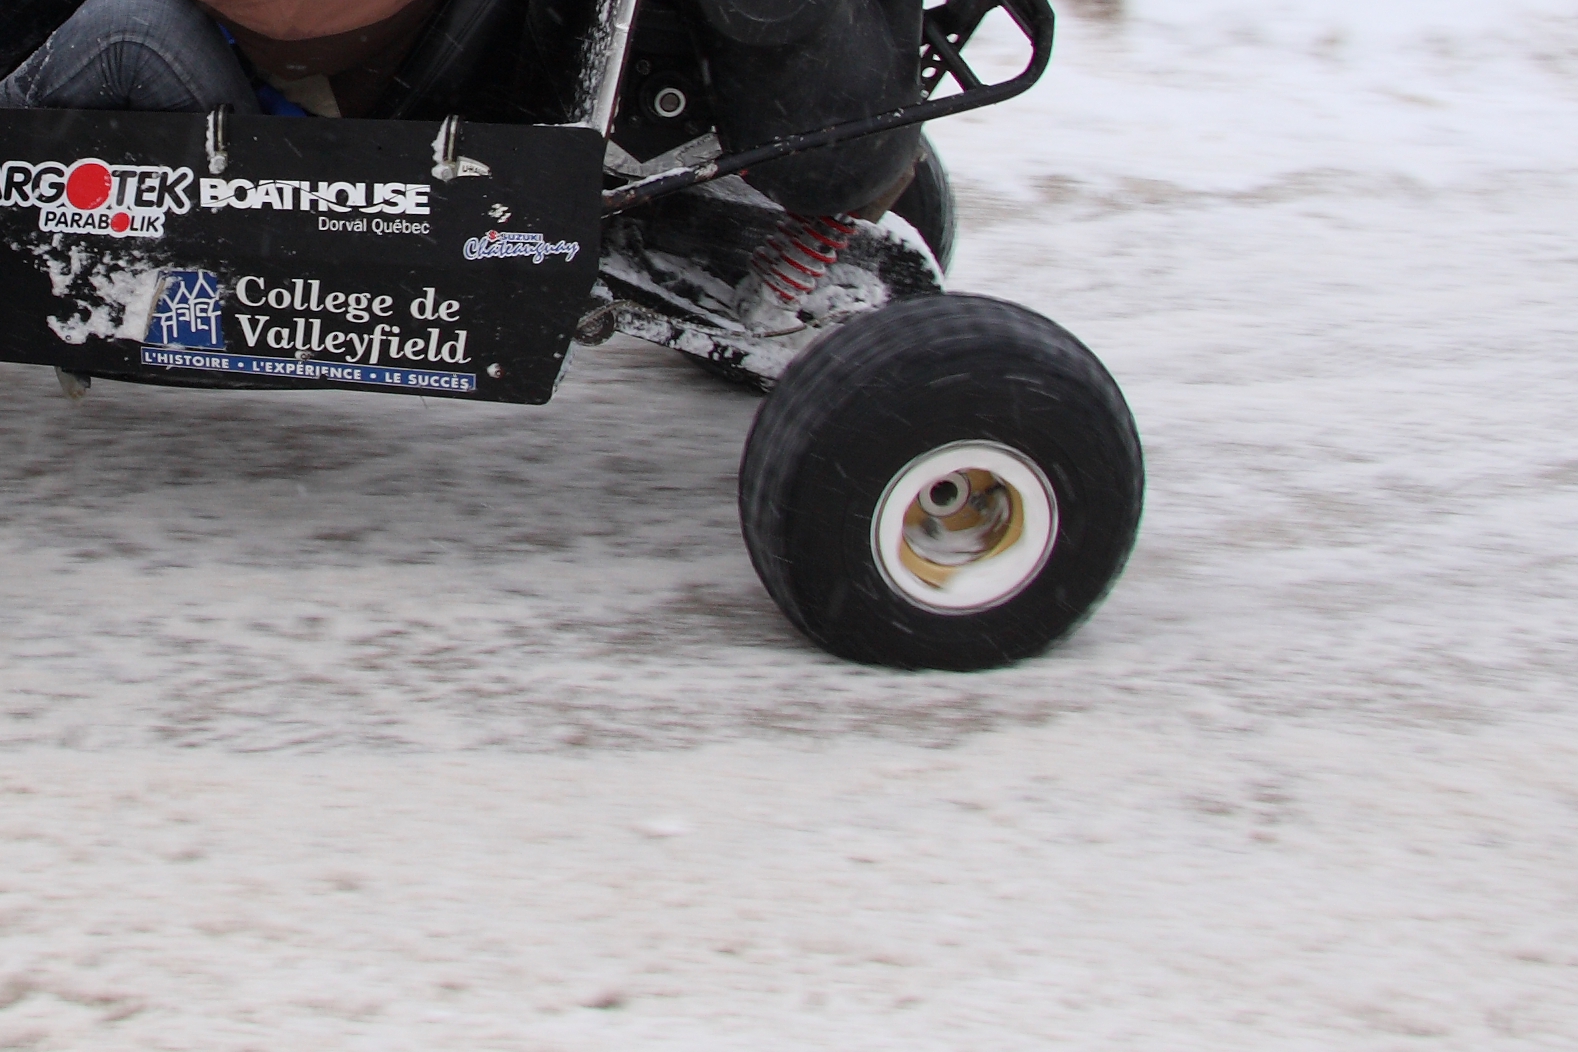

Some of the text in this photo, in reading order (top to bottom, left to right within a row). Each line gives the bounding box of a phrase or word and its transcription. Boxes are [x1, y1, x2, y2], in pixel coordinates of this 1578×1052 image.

[199, 177, 431, 215] BOATHOUSE
[42, 210, 162, 234] PARABOLIK
[318, 216, 430, 235] Dorval Québec
[501, 233, 543, 242] SUZUKI
[235, 275, 461, 323] College de
[235, 313, 472, 364] Valleyfield
[144, 351, 230, 369] L'HISTOIRE
[384, 371, 401, 383] LE
[408, 373, 469, 389] SUCCÈS
